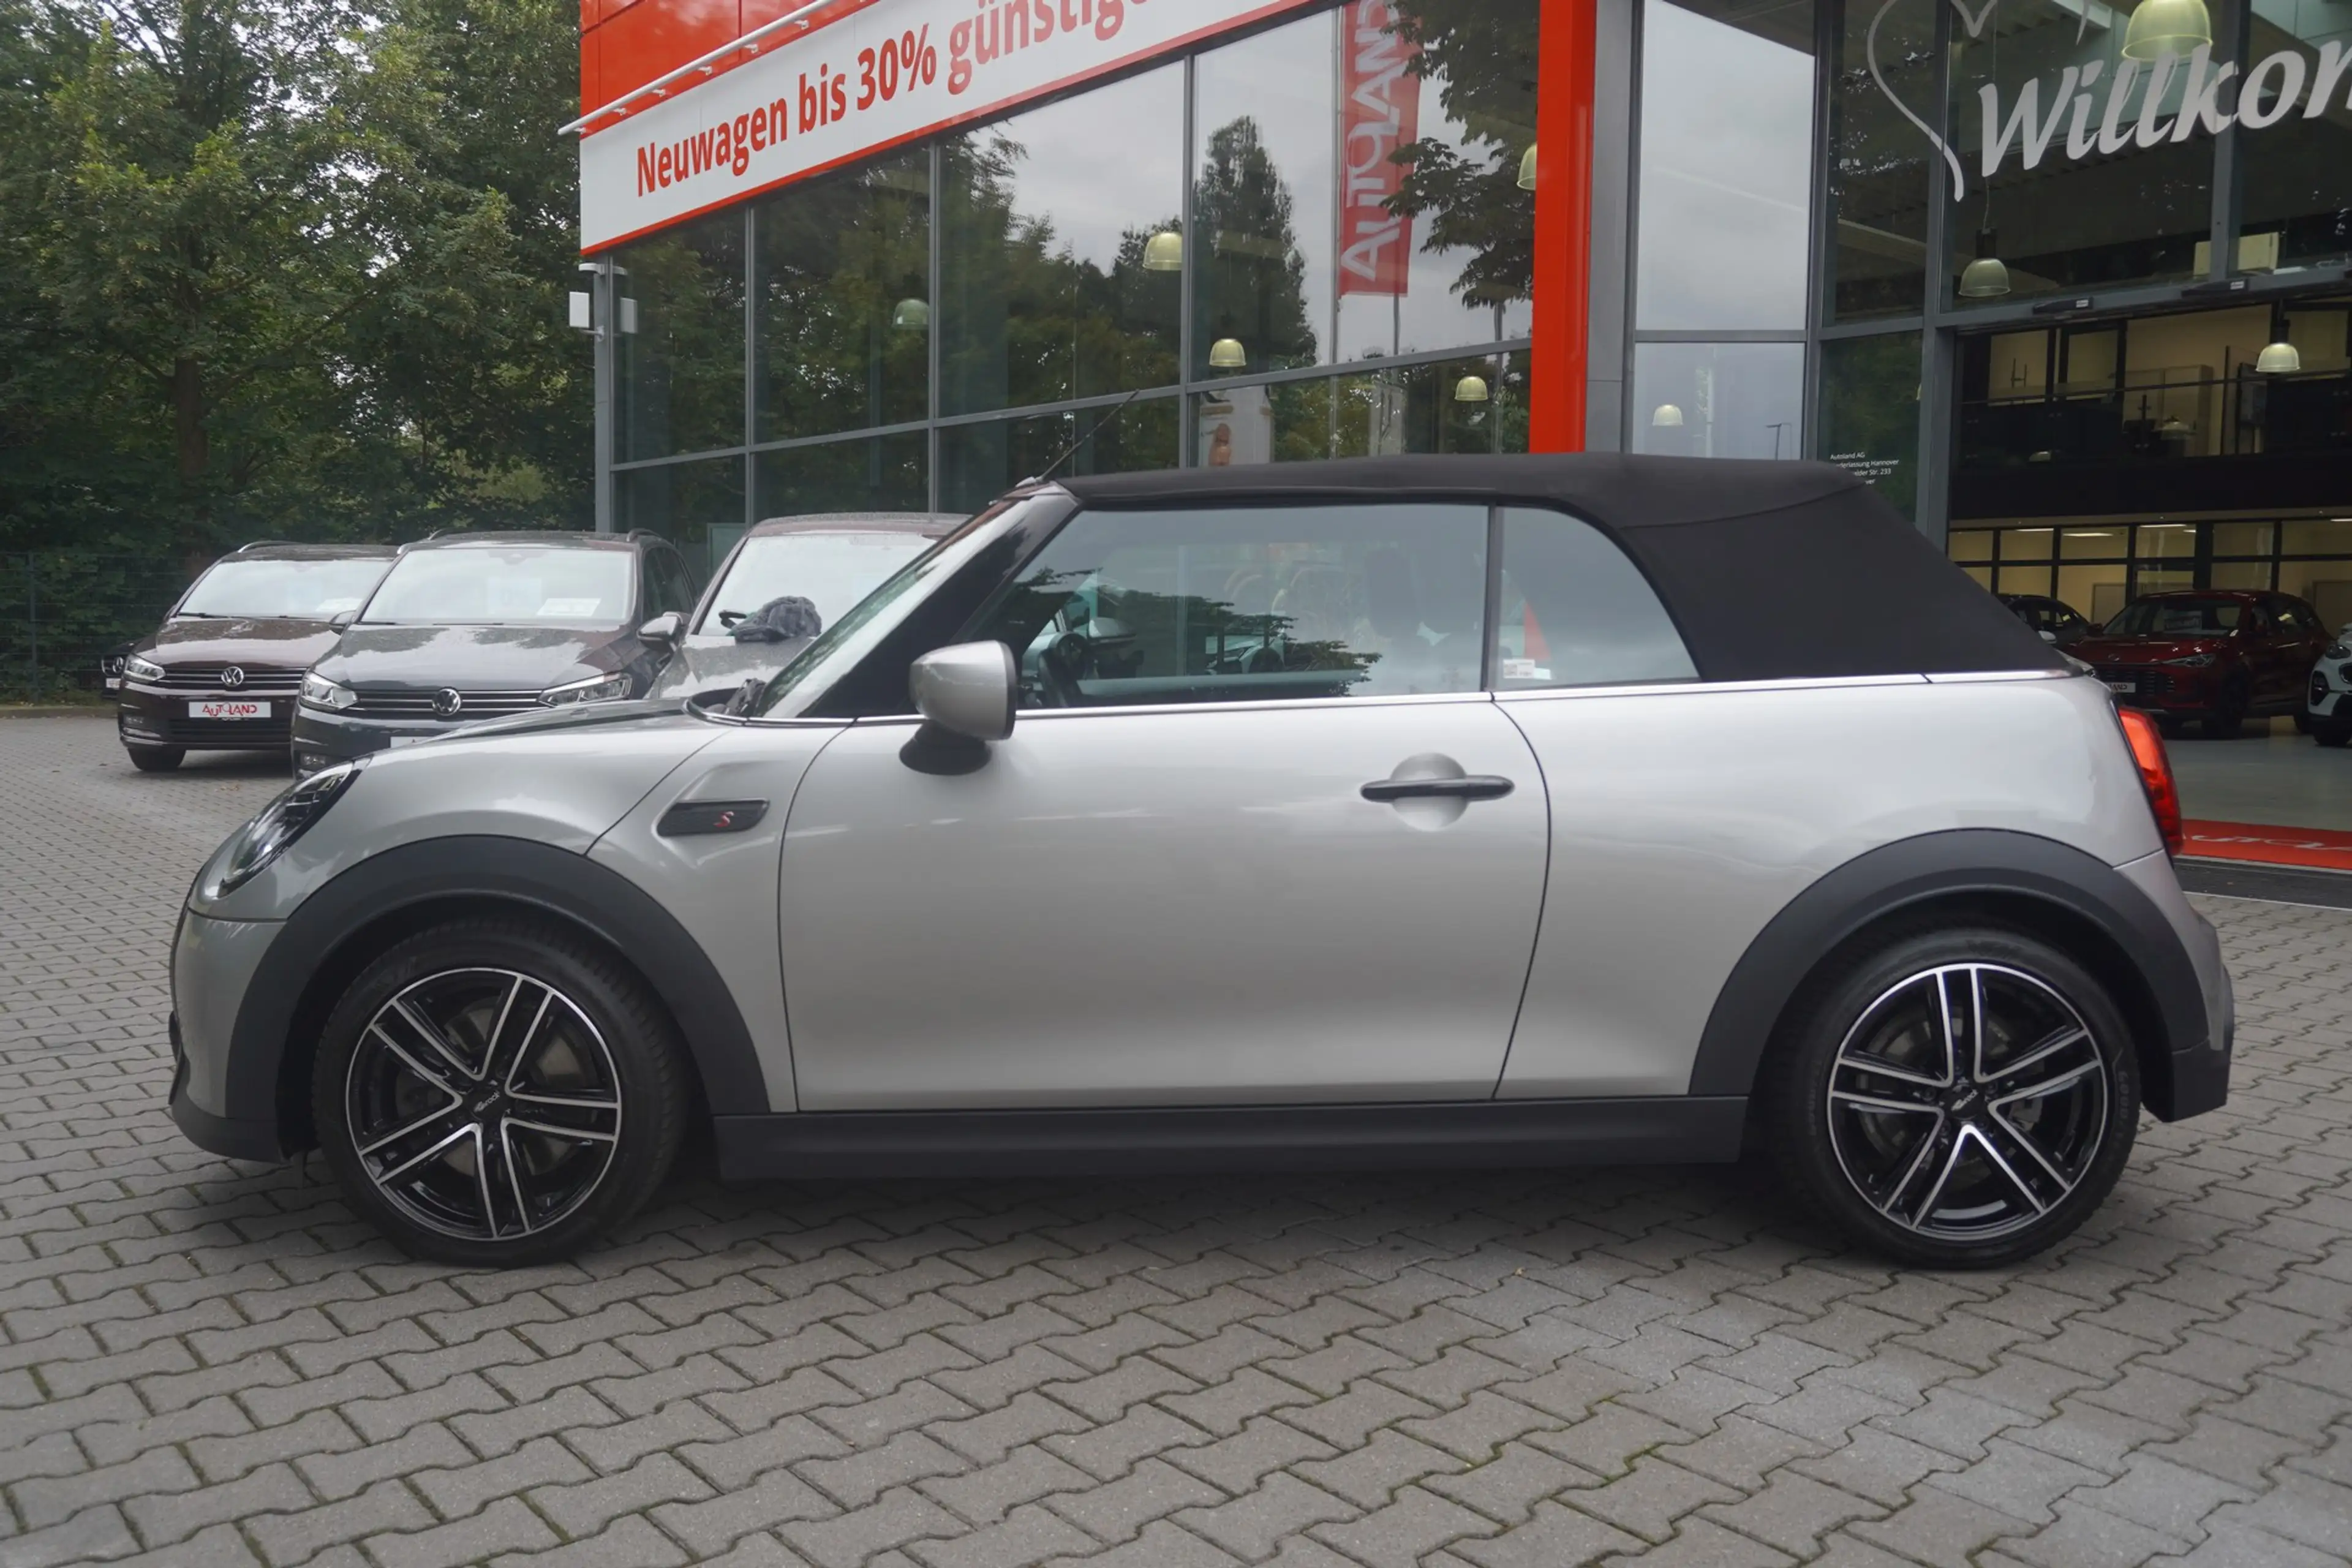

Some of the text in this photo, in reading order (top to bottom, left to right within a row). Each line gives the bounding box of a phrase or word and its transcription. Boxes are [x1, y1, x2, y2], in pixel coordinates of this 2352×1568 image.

[637, 0, 1147, 197] Neuwagen bis 30% günstg
